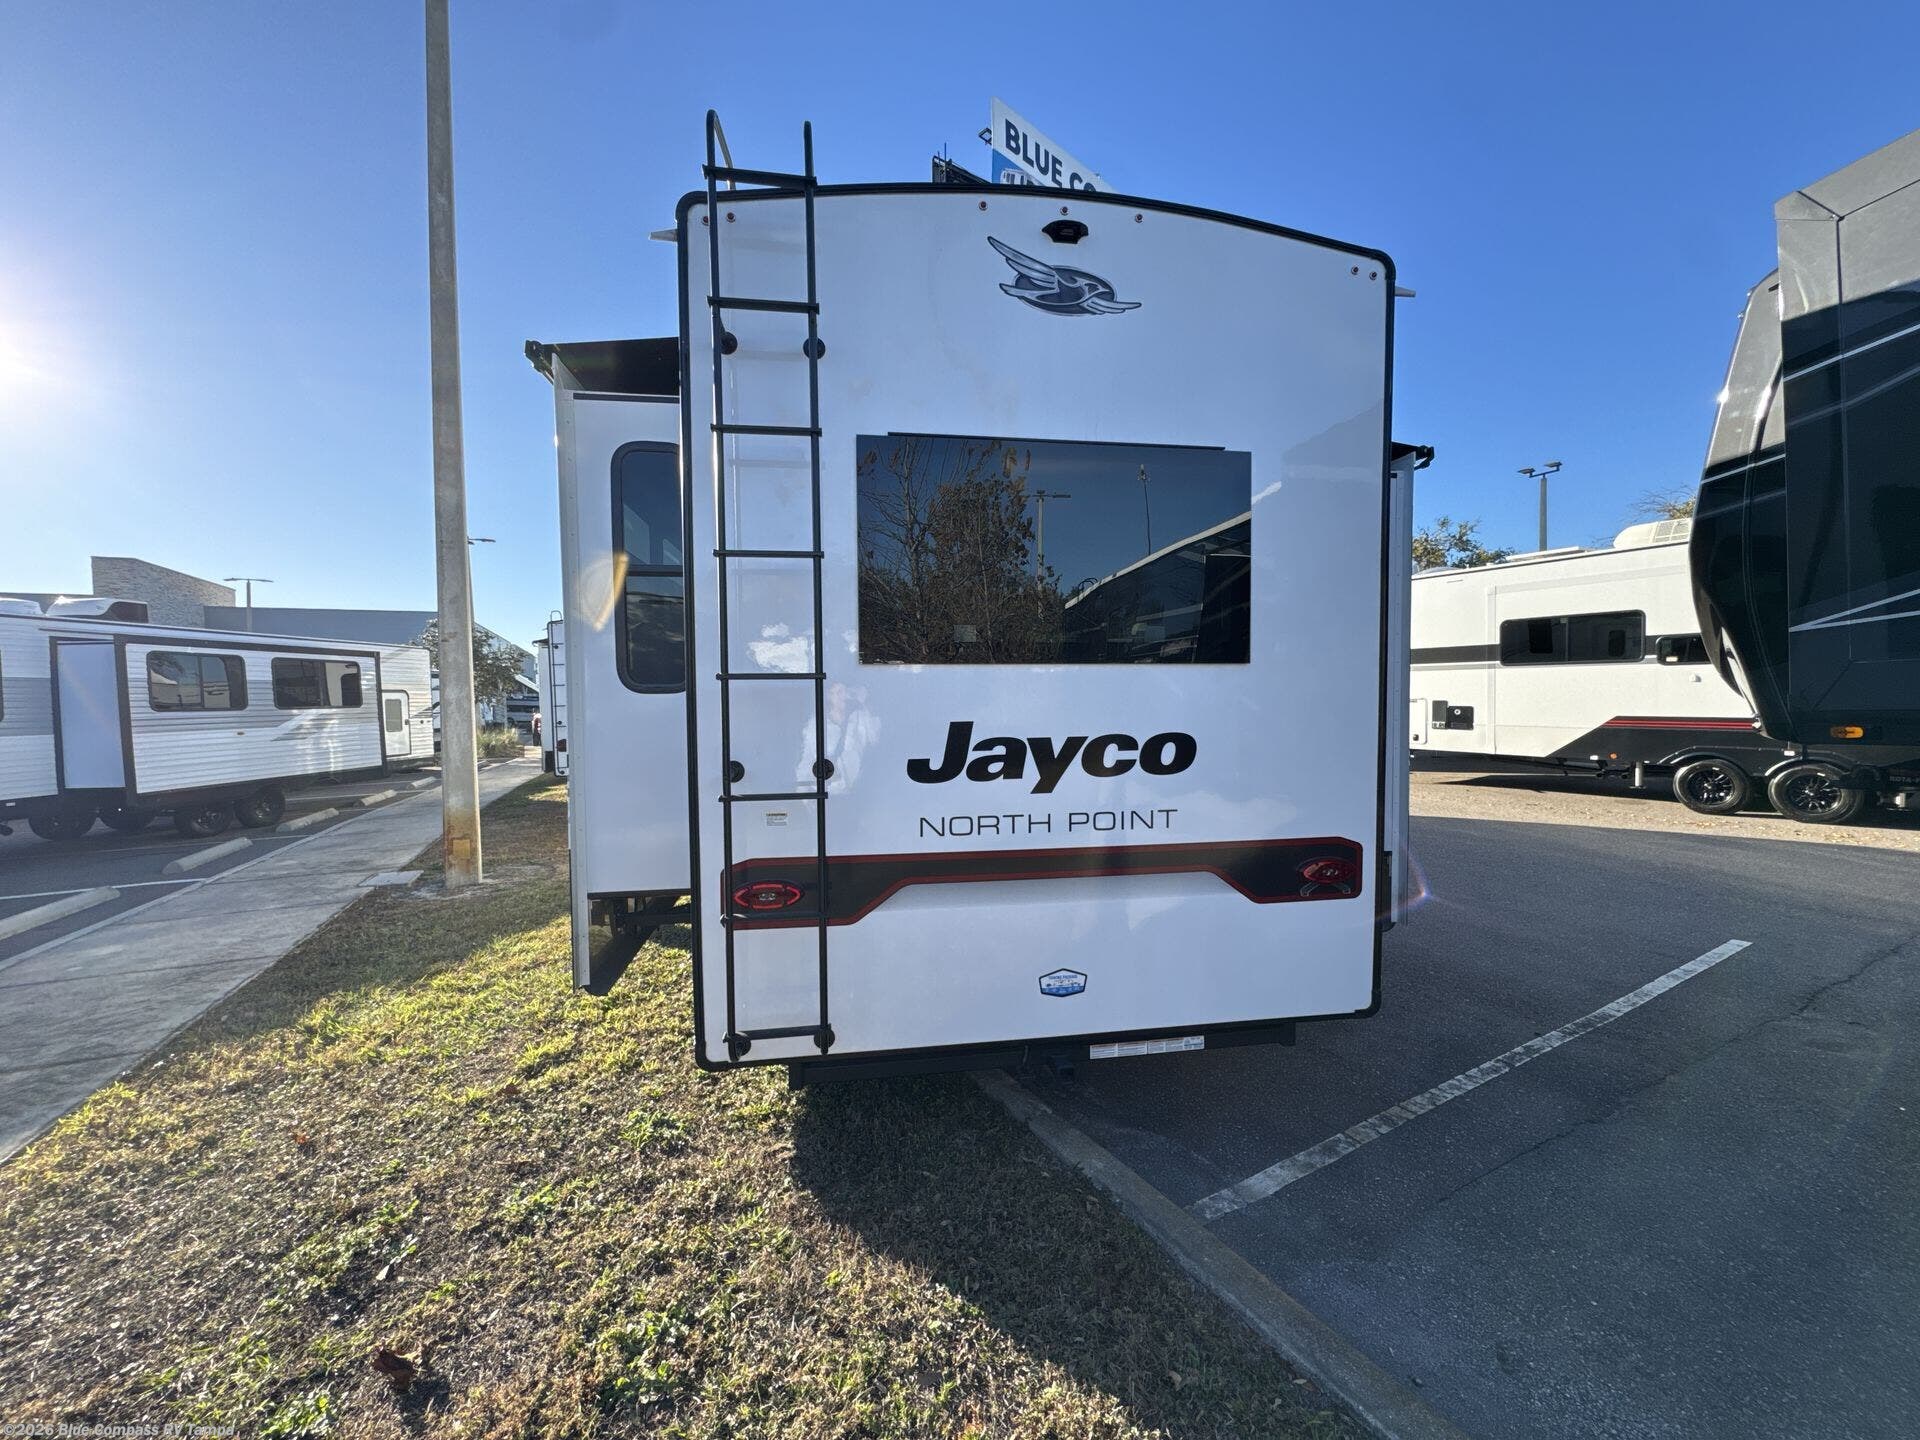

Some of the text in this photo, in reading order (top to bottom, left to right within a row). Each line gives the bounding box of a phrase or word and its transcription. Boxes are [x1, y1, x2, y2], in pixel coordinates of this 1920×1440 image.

[1005, 118, 1063, 188] BLUE
[906, 721, 1197, 794] Jayco
[919, 809, 1178, 837] NORTH POINT
